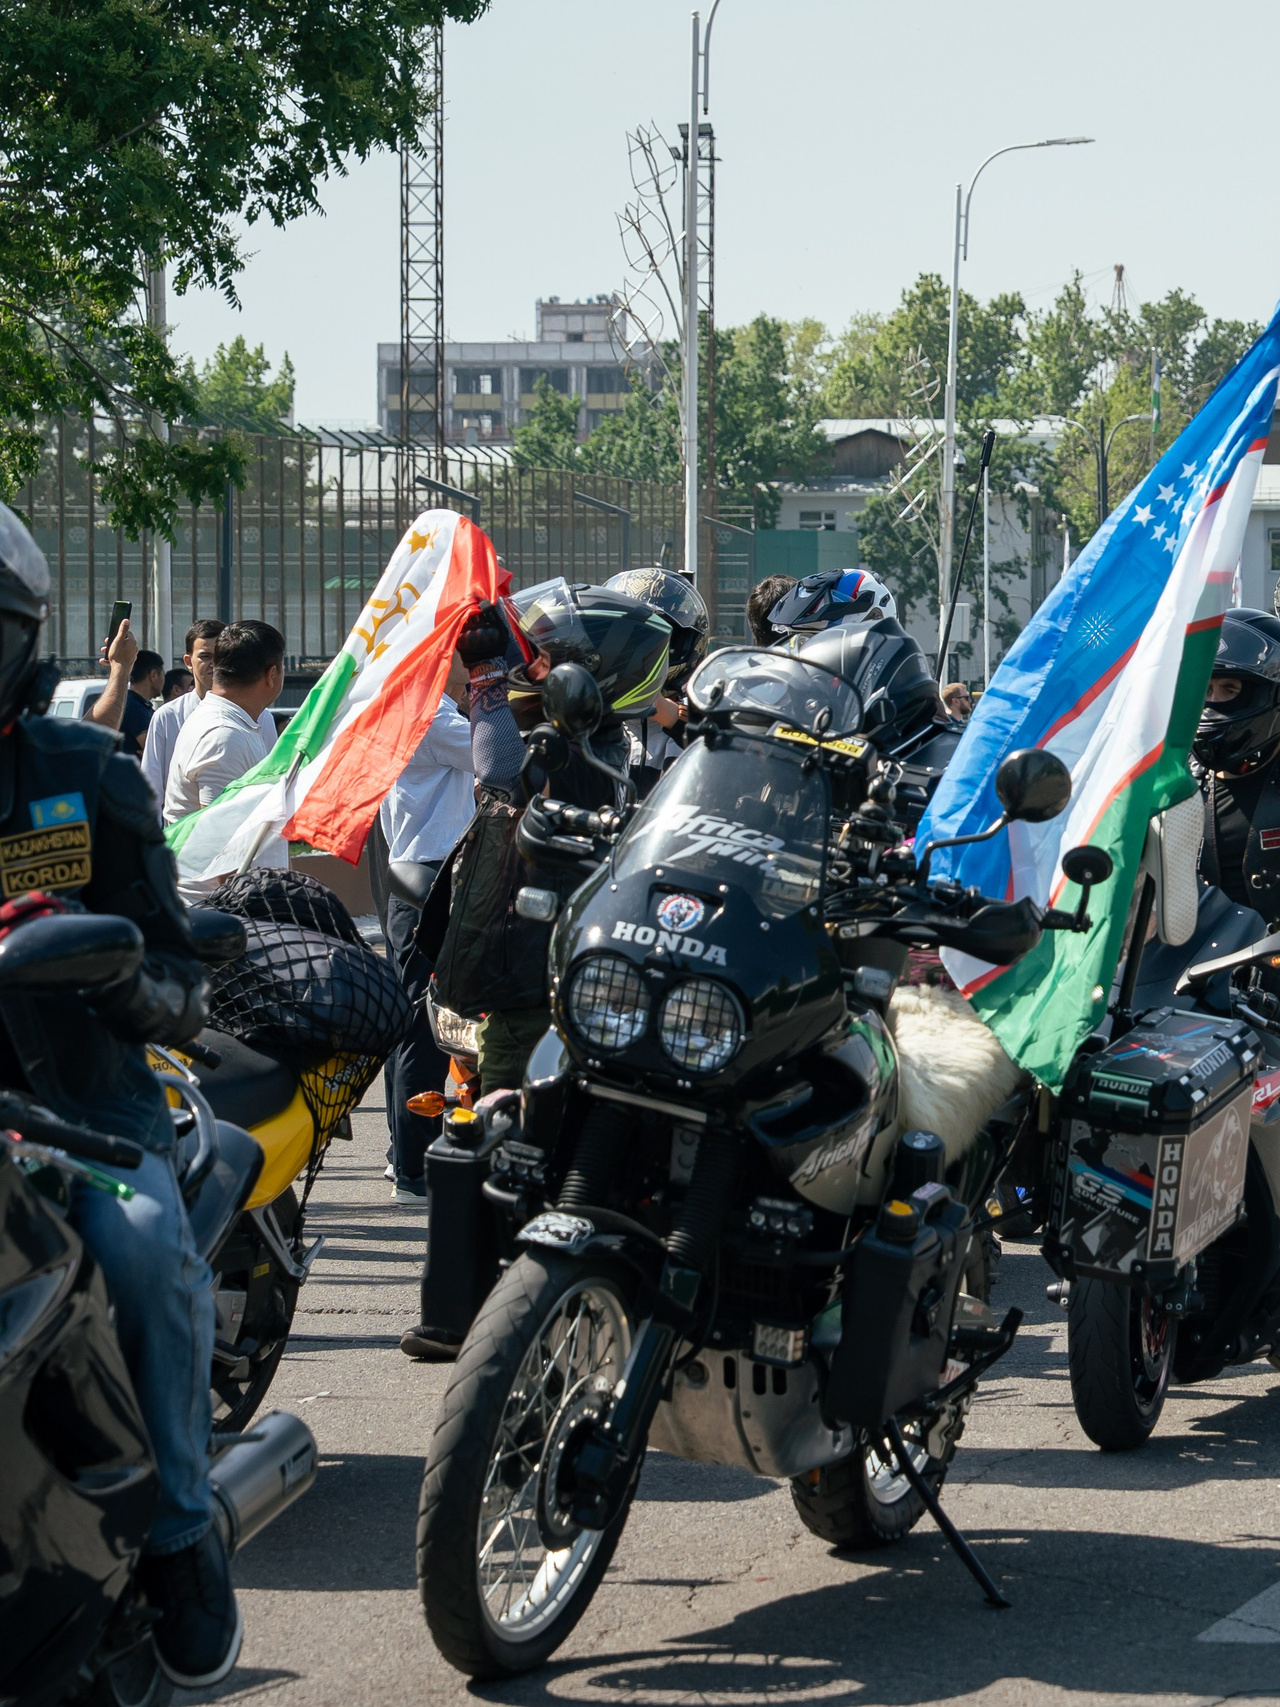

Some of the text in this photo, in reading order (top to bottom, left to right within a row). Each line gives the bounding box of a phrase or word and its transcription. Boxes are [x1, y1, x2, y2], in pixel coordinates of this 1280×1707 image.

[628, 803, 788, 853] Africa
[665, 833, 784, 878] Twin
[611, 920, 728, 967] HONDA
[1193, 1044, 1235, 1080] HONDA
[1074, 1186, 1140, 1225] ADVENTURE
[1075, 1171, 1127, 1205] GS
[1154, 1143, 1182, 1252] HONDA
